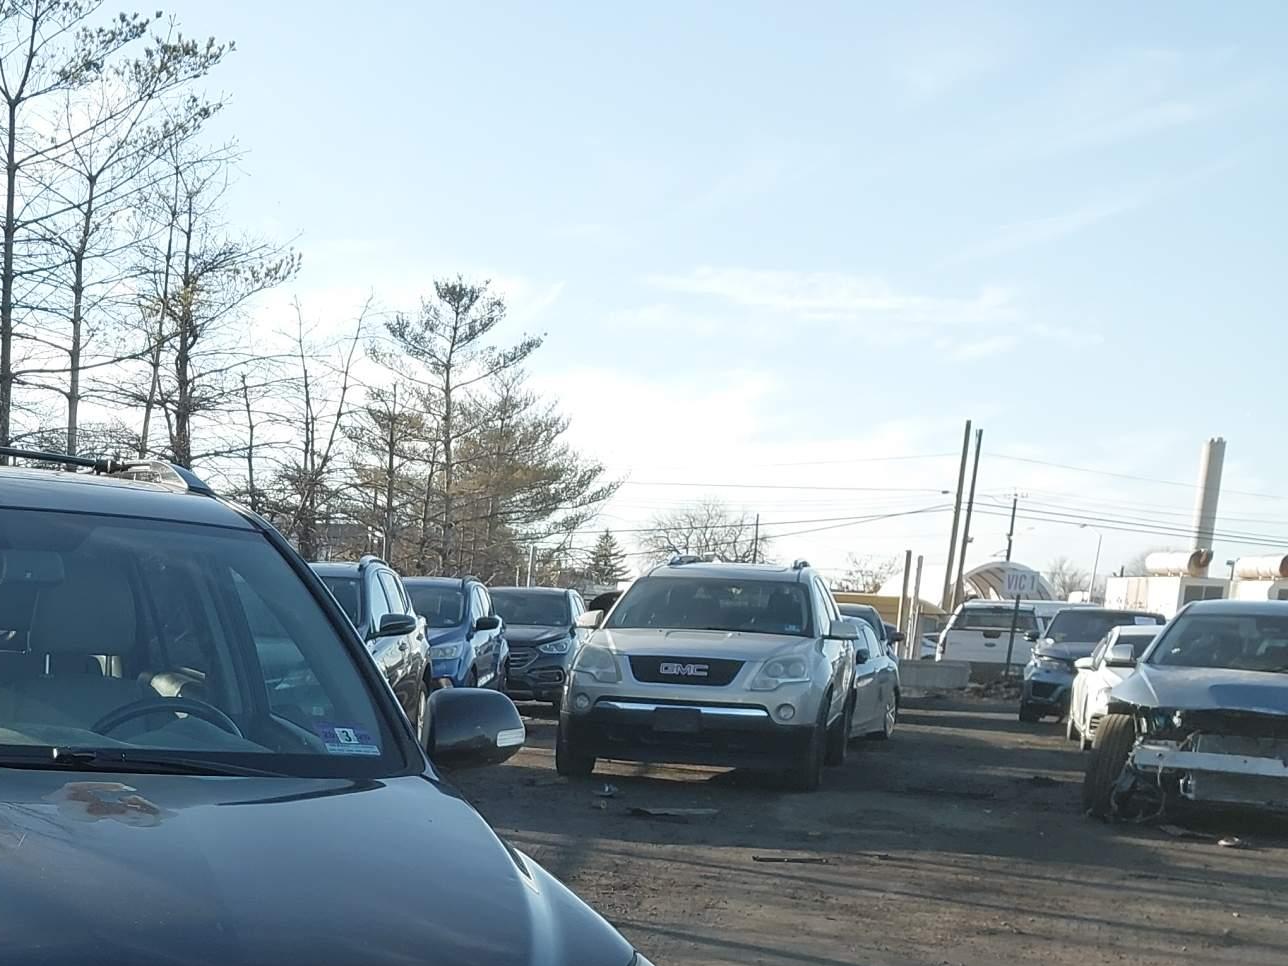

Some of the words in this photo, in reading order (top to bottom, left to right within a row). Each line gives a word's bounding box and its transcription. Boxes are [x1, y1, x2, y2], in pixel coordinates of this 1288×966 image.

[1007, 573, 1027, 591] VIC
[659, 662, 710, 677] GMC
[341, 729, 353, 742] 3
